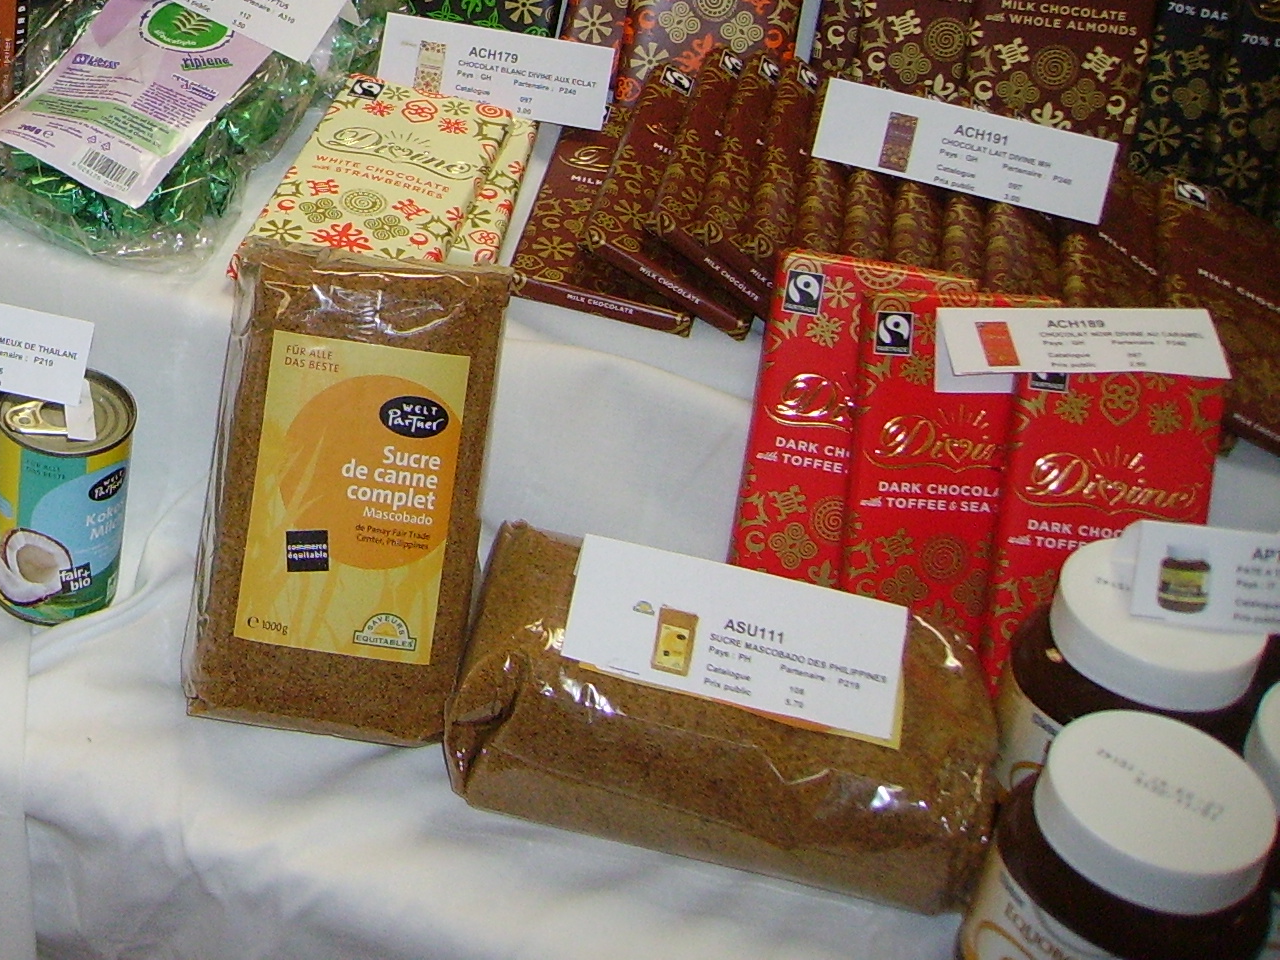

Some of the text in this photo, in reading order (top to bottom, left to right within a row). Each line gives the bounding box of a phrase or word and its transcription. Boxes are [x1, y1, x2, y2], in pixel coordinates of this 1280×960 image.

[1001, 0, 1126, 22] MILK CHOCOLATE
[1167, 1, 1195, 15] 70%
[1009, 13, 1137, 37] WHOLE ALMONDS
[469, 46, 518, 64] ACH179
[458, 60, 499, 74] CHOCOLAT
[501, 67, 526, 78] BLANC
[954, 124, 1009, 146] ACH191
[941, 137, 985, 155] CHOCOLAT
[316, 154, 450, 193] WHITE CHOCOLATE
[331, 166, 444, 200] STRAWBERRIES
[640, 266, 702, 305] MILK CHOCOLATE
[704, 257, 760, 302] MILK CHOCOLATE
[567, 293, 634, 315] MILK CHOCOLATE
[1047, 318, 1106, 329] ACH189
[286, 345, 333, 360] FÜR ALLE
[284, 357, 339, 373] DAS BESTE
[775, 436, 819, 452] DARK
[383, 445, 441, 471] Sucre
[782, 454, 843, 474] TOFFEE
[342, 459, 438, 489] de canne
[347, 482, 436, 511] complet
[878, 481, 923, 494] DARK
[885, 497, 990, 513] TOFFEE SEA
[363, 506, 432, 526] Mascobado
[1027, 519, 1072, 535] DARK
[262, 620, 288, 635] 1000g
[367, 615, 406, 636] SAVEURS
[724, 619, 785, 644] ASU111
[355, 634, 415, 649] EQUITABLES
[710, 633, 888, 684] SUCRE MASCOBADO DES PHILIPPINES
